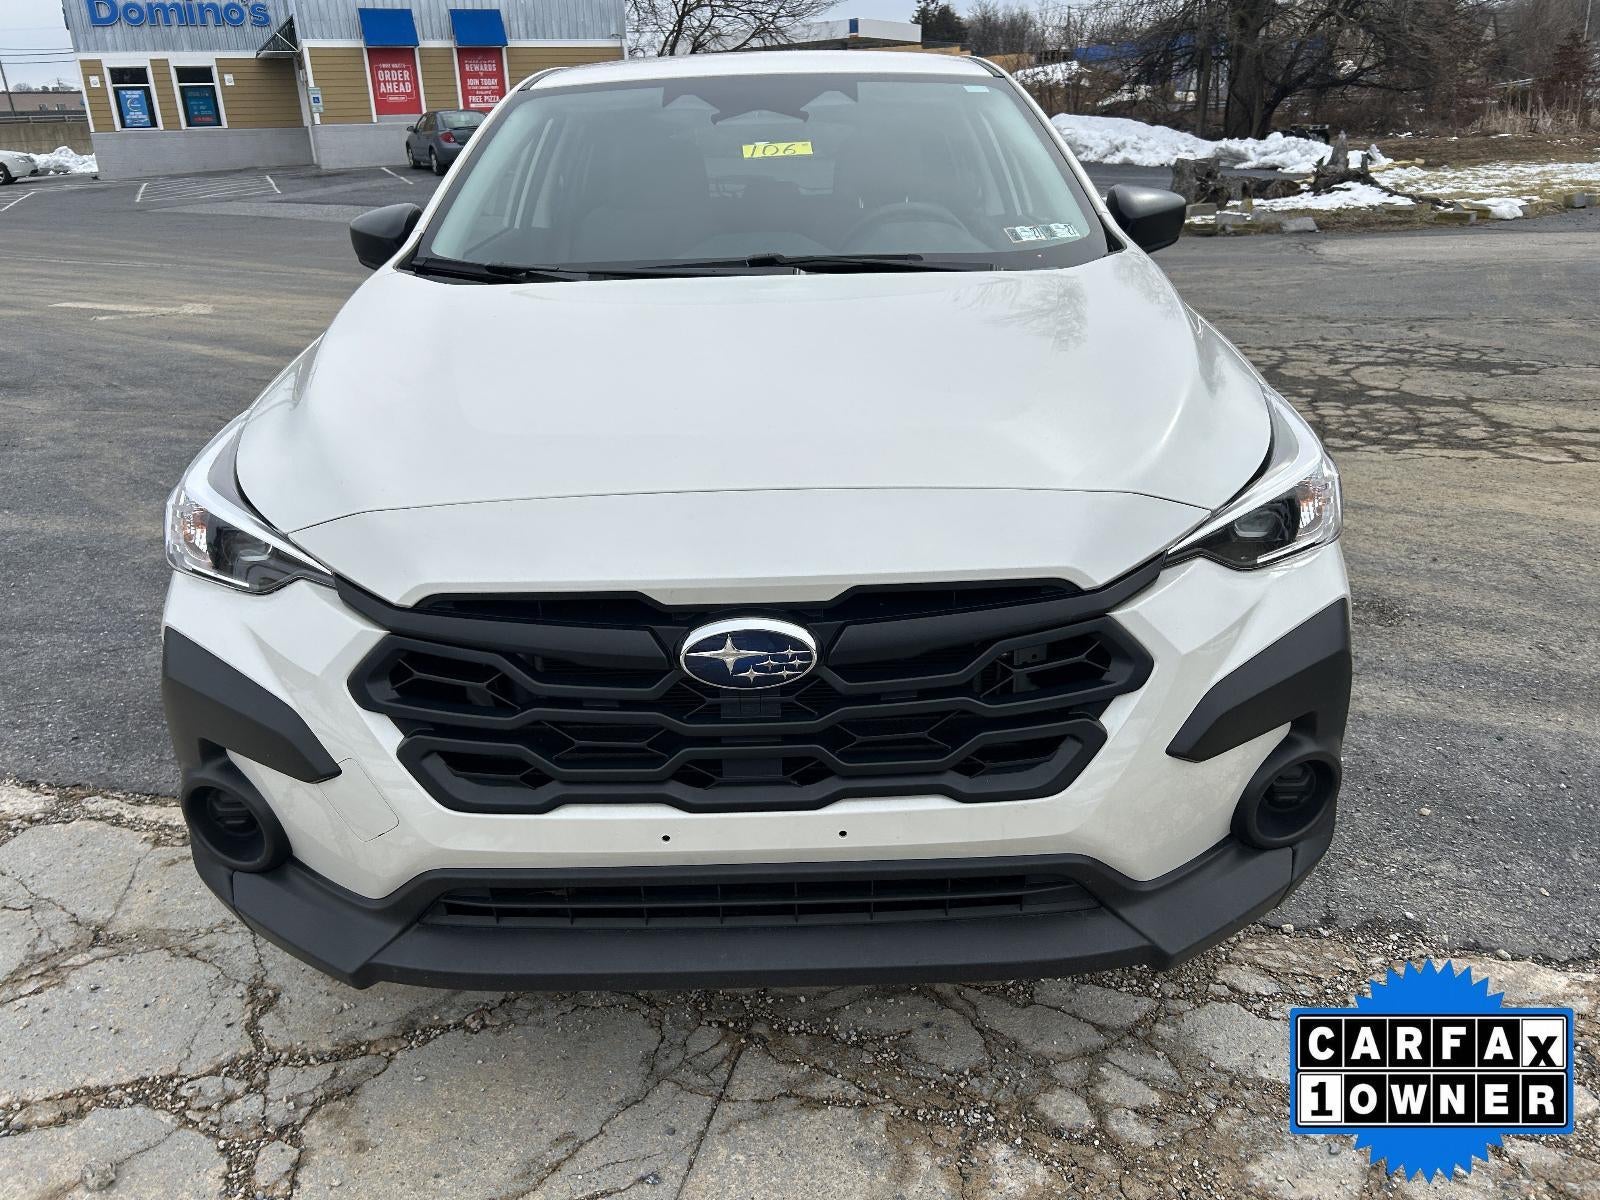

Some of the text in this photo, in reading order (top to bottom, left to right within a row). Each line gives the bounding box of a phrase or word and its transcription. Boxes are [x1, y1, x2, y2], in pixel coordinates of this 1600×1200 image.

[86, 0, 271, 27] Domino's
[465, 63, 497, 72] REWARDS
[377, 70, 410, 81] ORDER
[380, 81, 412, 93] AHEAD
[467, 78, 498, 86] JOIN TODAY
[469, 95, 483, 103] FREE
